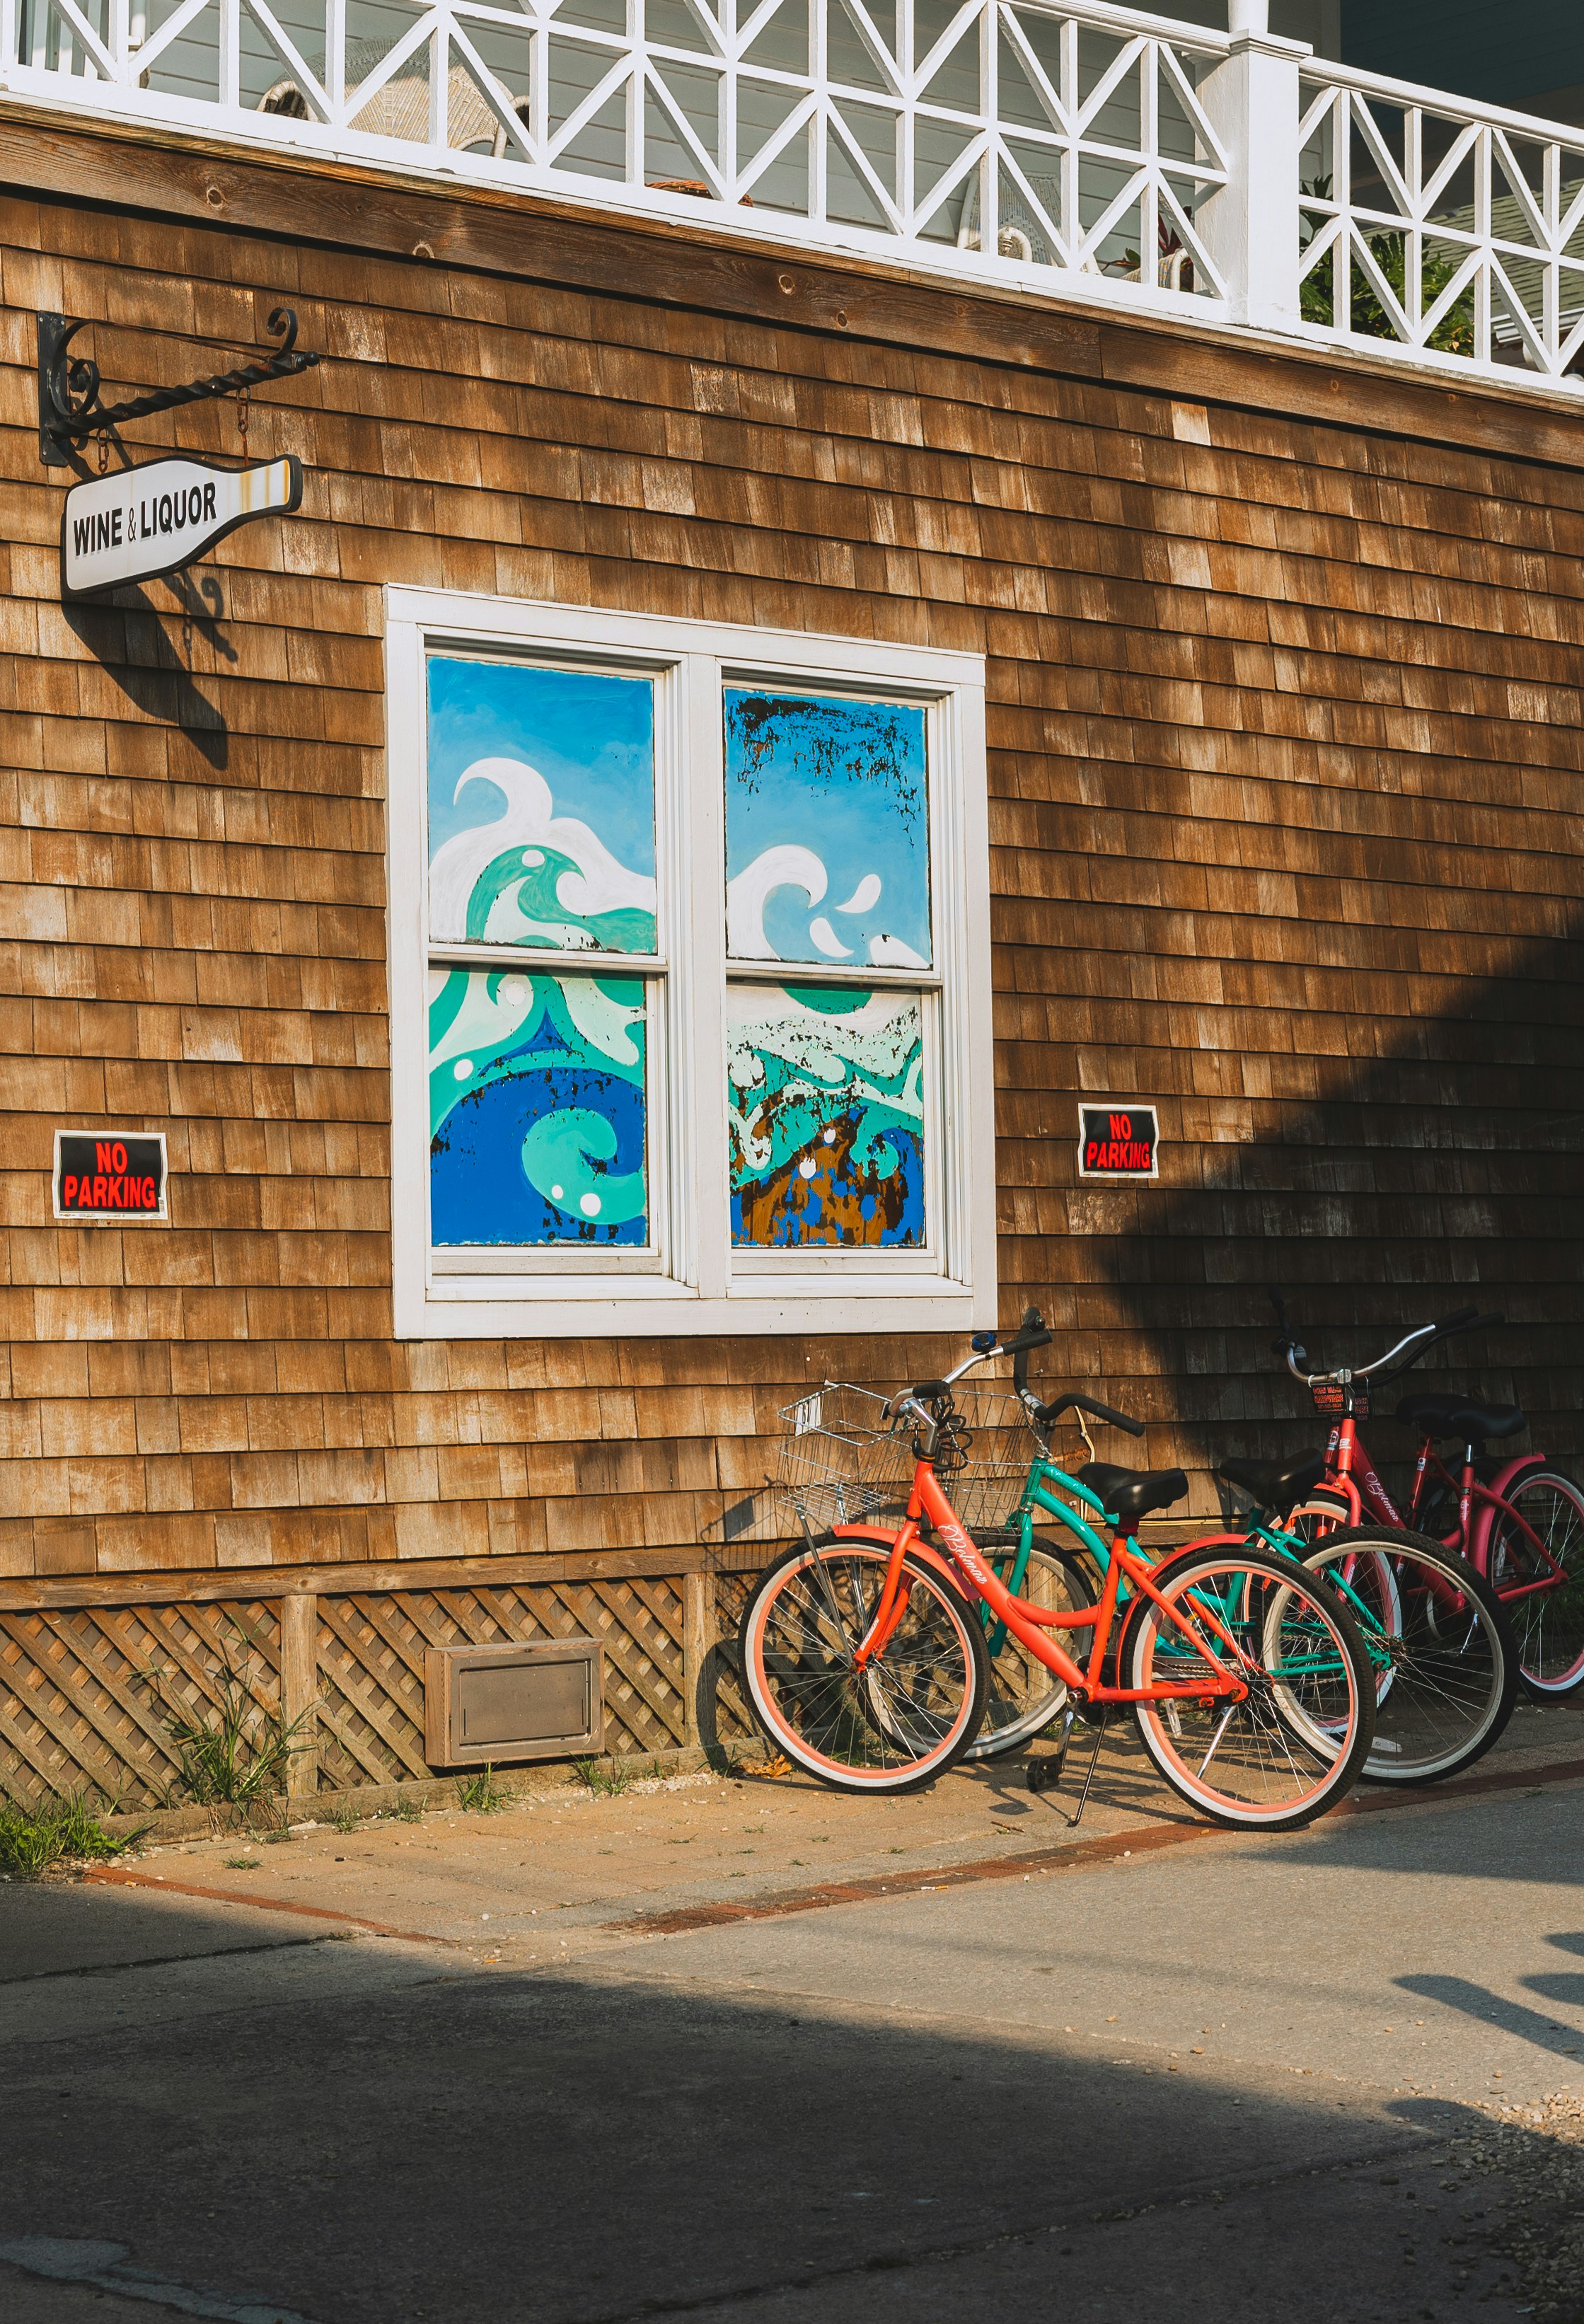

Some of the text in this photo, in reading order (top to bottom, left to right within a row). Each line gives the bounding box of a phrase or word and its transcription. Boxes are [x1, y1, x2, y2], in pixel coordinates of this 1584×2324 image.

[74, 482, 217, 558] WINE & LIQUOR
[1109, 1114, 1133, 1140] NO
[96, 1142, 128, 1174] NO
[1086, 1141, 1150, 1169] PARKING
[64, 1175, 156, 1209] PARKING
